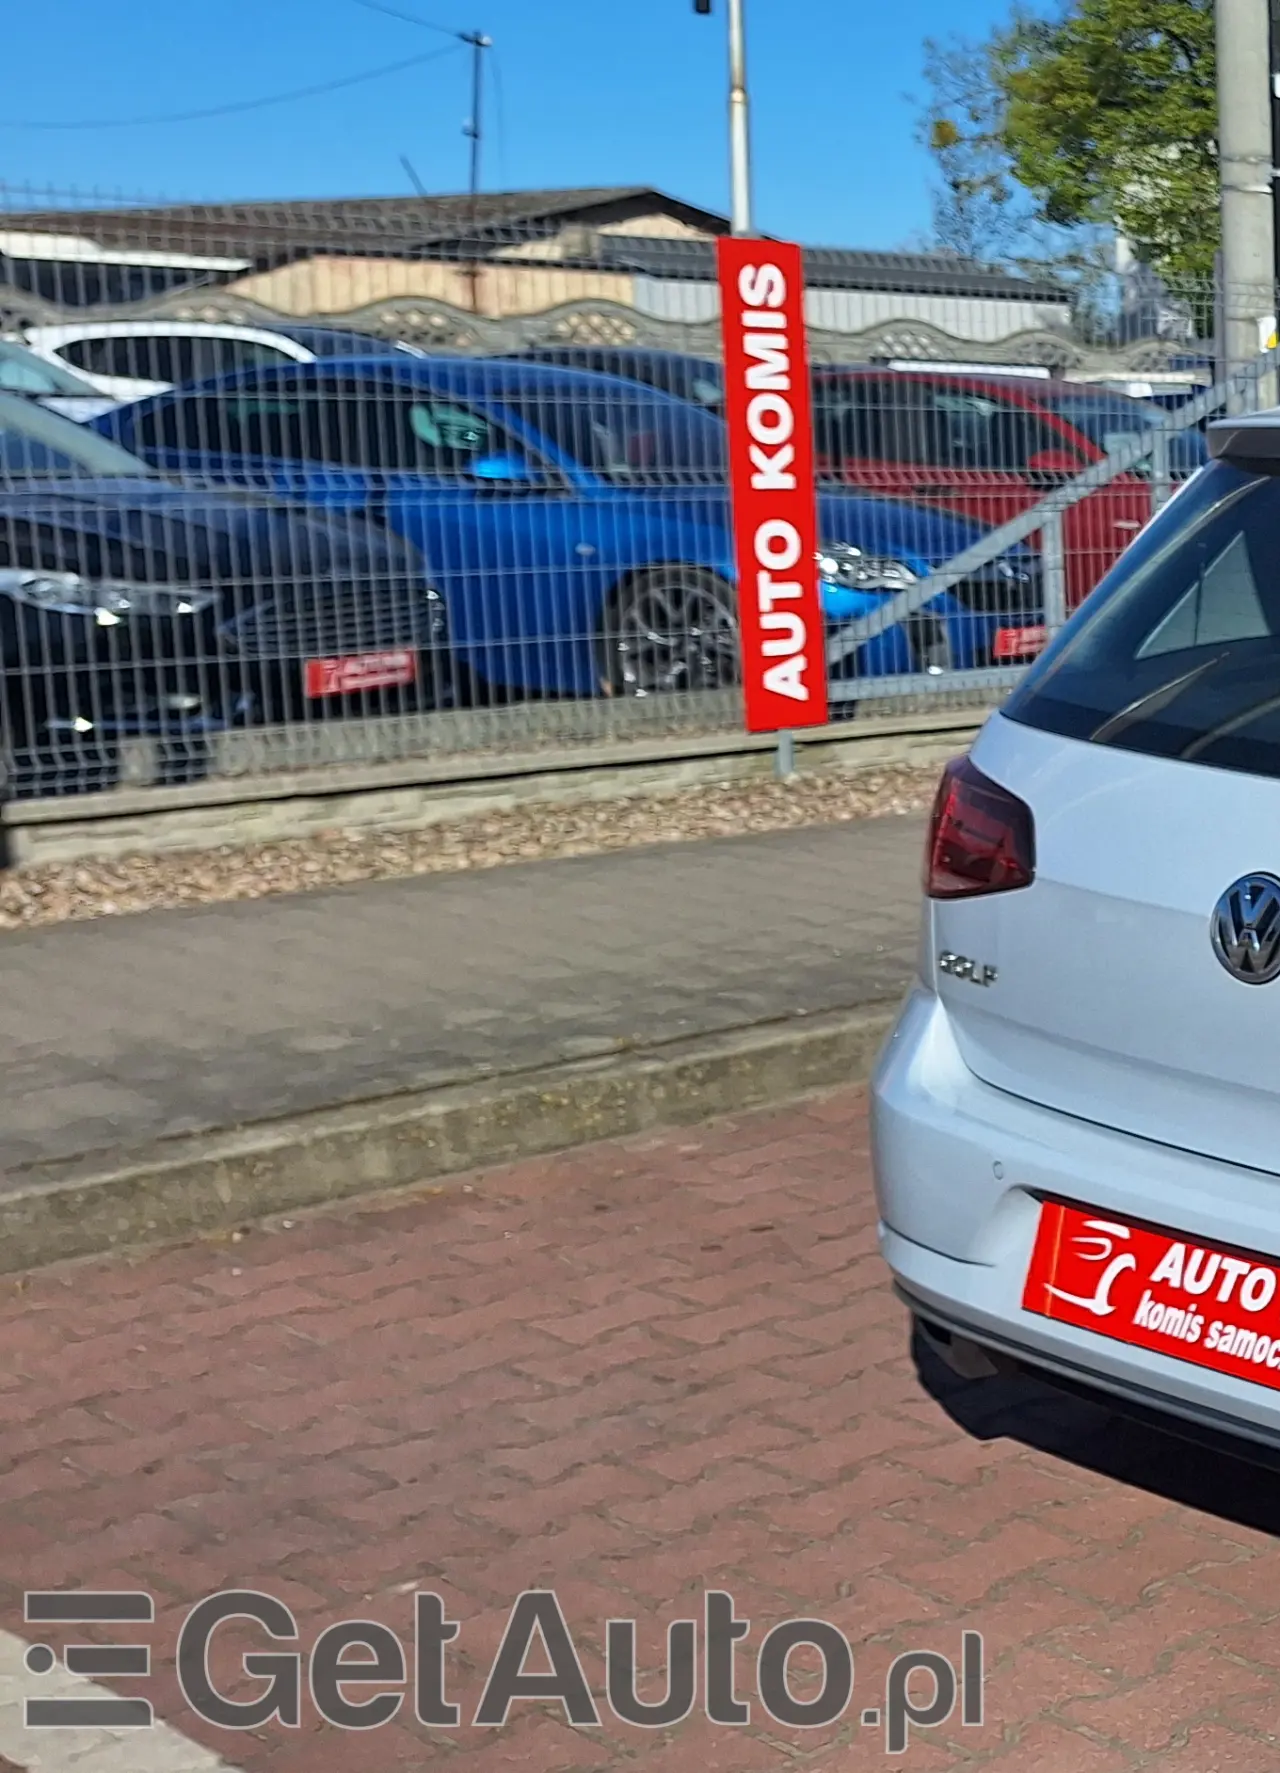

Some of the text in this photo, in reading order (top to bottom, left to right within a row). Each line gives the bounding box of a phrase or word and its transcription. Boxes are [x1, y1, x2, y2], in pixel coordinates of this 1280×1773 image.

[737, 262, 810, 702] AUTO KOMIS
[1149, 1242, 1277, 1313] AUTO
[1132, 1290, 1204, 1344] komis
